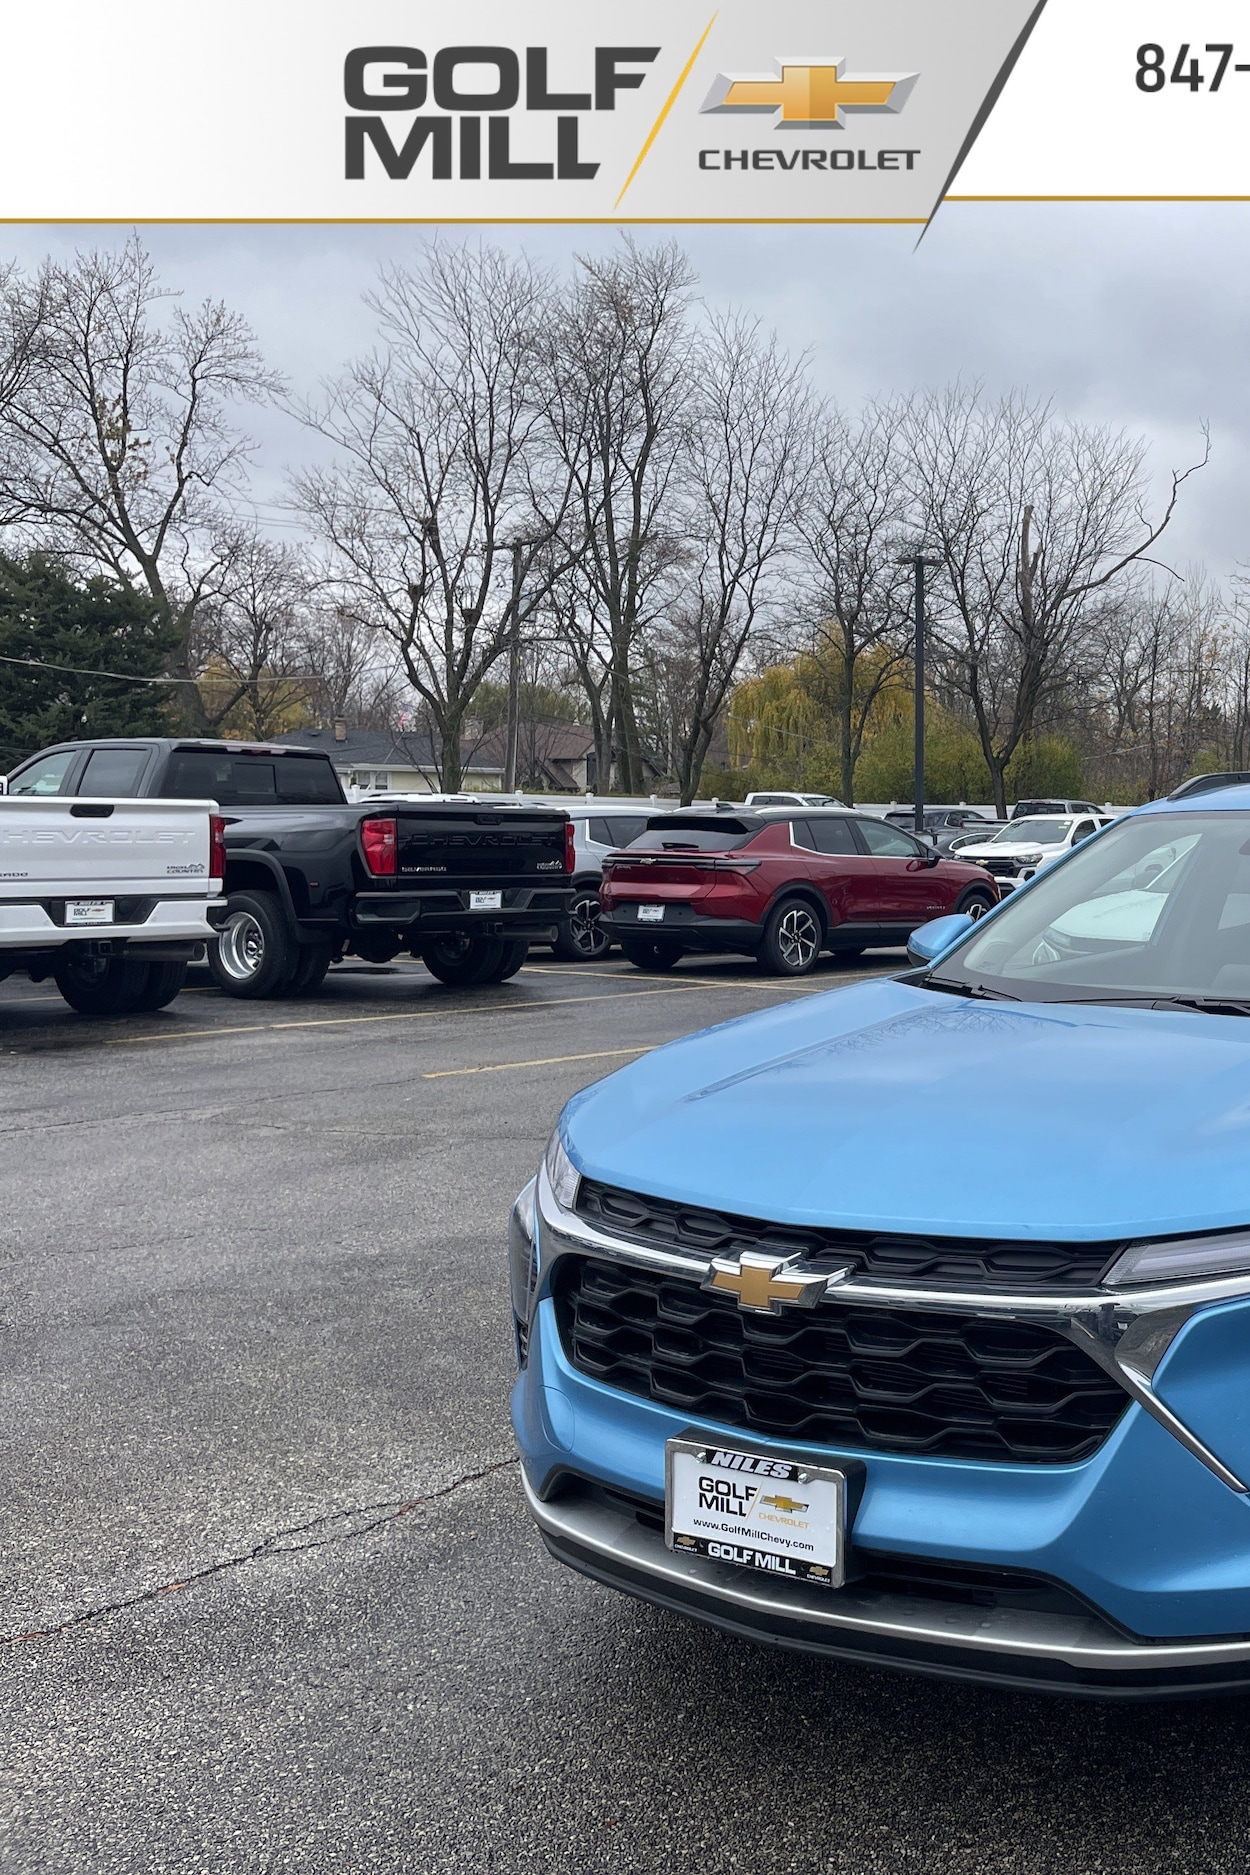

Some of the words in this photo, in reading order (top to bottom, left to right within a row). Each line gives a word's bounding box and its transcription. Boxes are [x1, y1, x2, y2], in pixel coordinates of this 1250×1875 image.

[711, 1451, 793, 1480] NILES
[698, 1476, 758, 1501] GOLF
[698, 1492, 748, 1518] MILL
[692, 1517, 815, 1552] www.GolfMillChevy.com
[758, 1512, 811, 1530] CHEVROLET
[707, 1542, 754, 1564] GOLF
[754, 1551, 797, 1576] MILL
